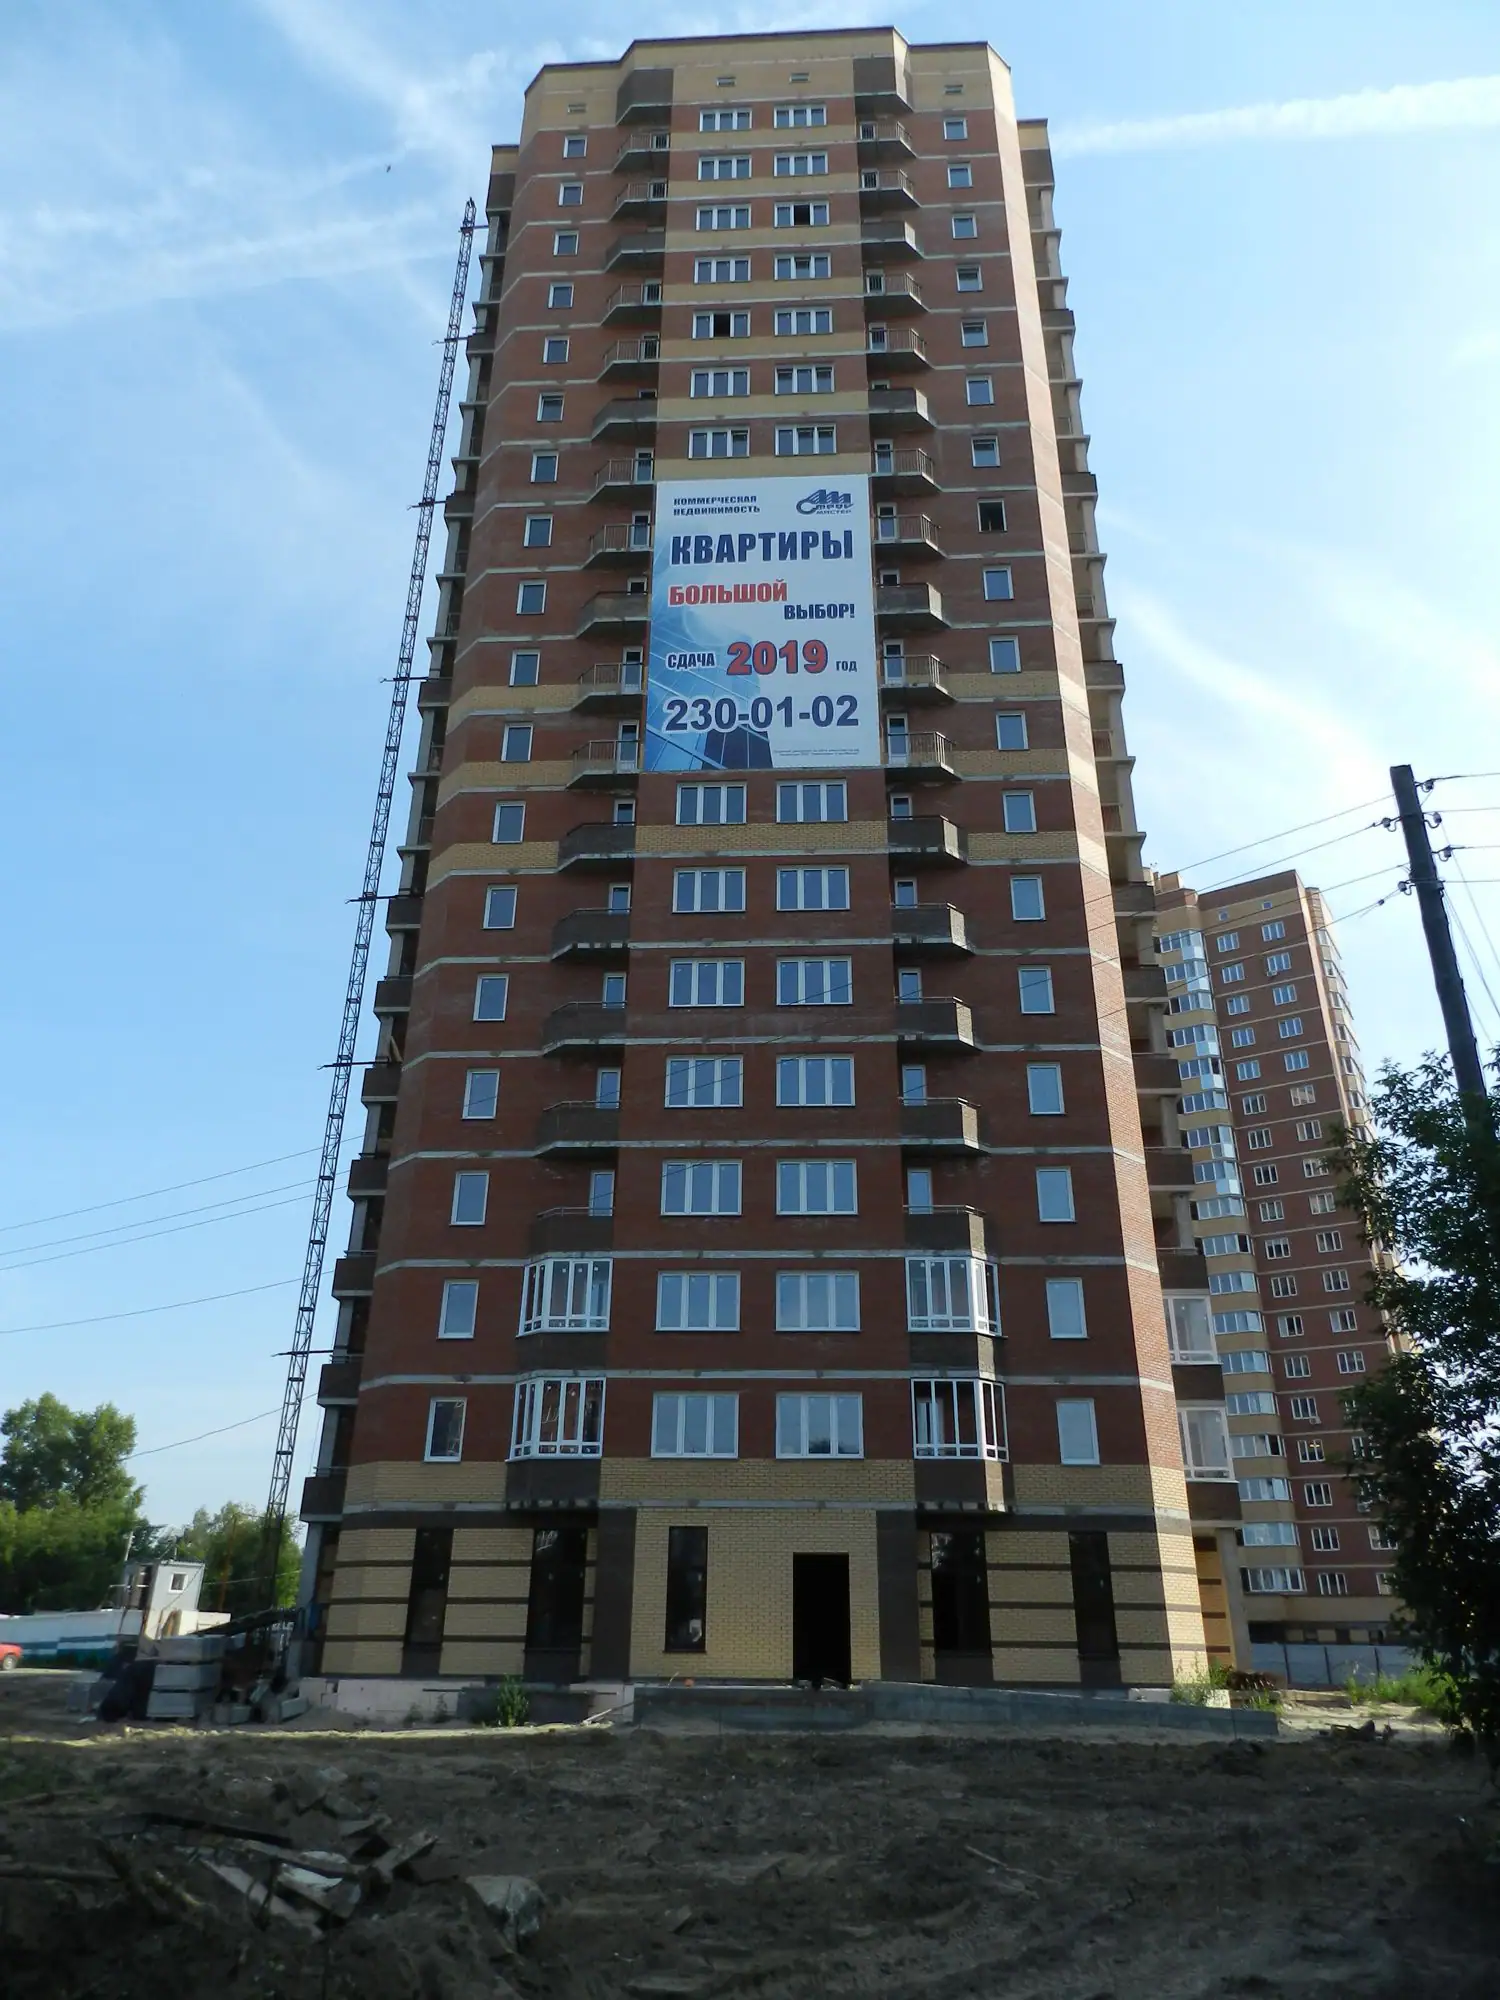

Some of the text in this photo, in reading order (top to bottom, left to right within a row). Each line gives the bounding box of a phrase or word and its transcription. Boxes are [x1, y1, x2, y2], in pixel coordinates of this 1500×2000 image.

[674, 506, 760, 516] НЕДВИЖИМОСТЬ
[671, 530, 854, 565] КВАРТИРЫ
[669, 579, 788, 606] БОЛЬШОЙ
[784, 603, 855, 620] ВЫБОР!
[668, 653, 715, 669] СДАЧА
[726, 640, 828, 675] 2019
[665, 695, 859, 731] 230-01-02
